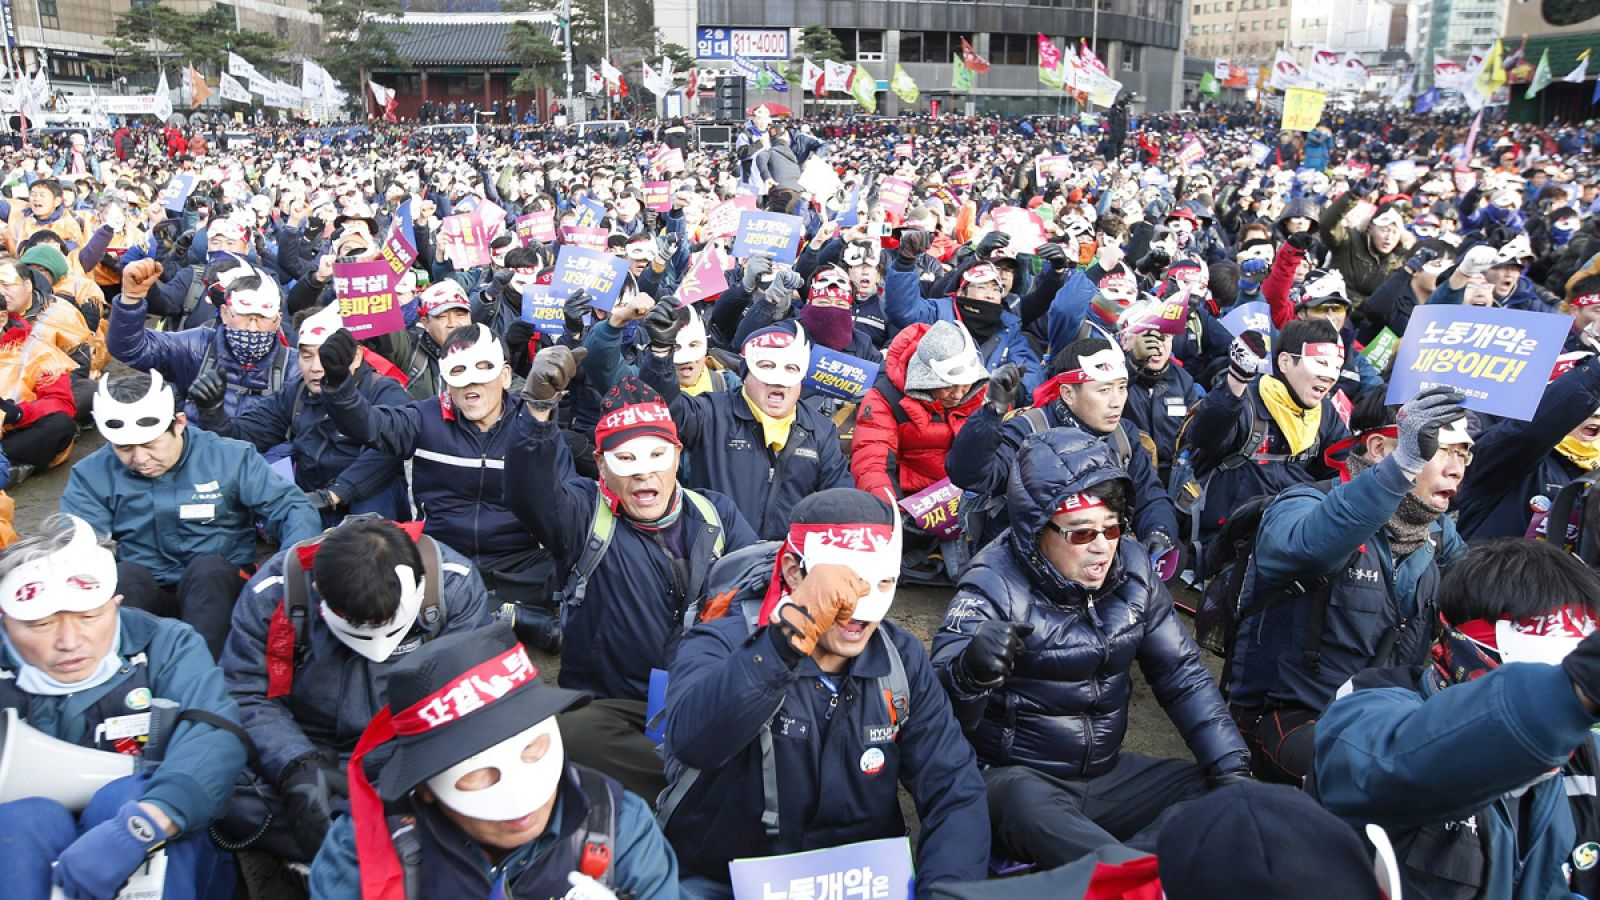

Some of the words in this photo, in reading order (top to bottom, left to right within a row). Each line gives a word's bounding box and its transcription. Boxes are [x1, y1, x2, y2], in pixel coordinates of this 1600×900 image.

[698, 40, 729, 56] 임대
[733, 33, 785, 53] 311-4000
[564, 255, 618, 280] 노동개악은
[562, 270, 613, 293] 재앙이다!
[340, 293, 393, 317] 총파업!
[1419, 321, 1539, 356] 노동개악은
[815, 356, 868, 383] 노동개악은
[1410, 347, 1529, 383] 재앙이다!
[811, 370, 864, 394] 재앙이다!
[922, 505, 947, 529] 가자
